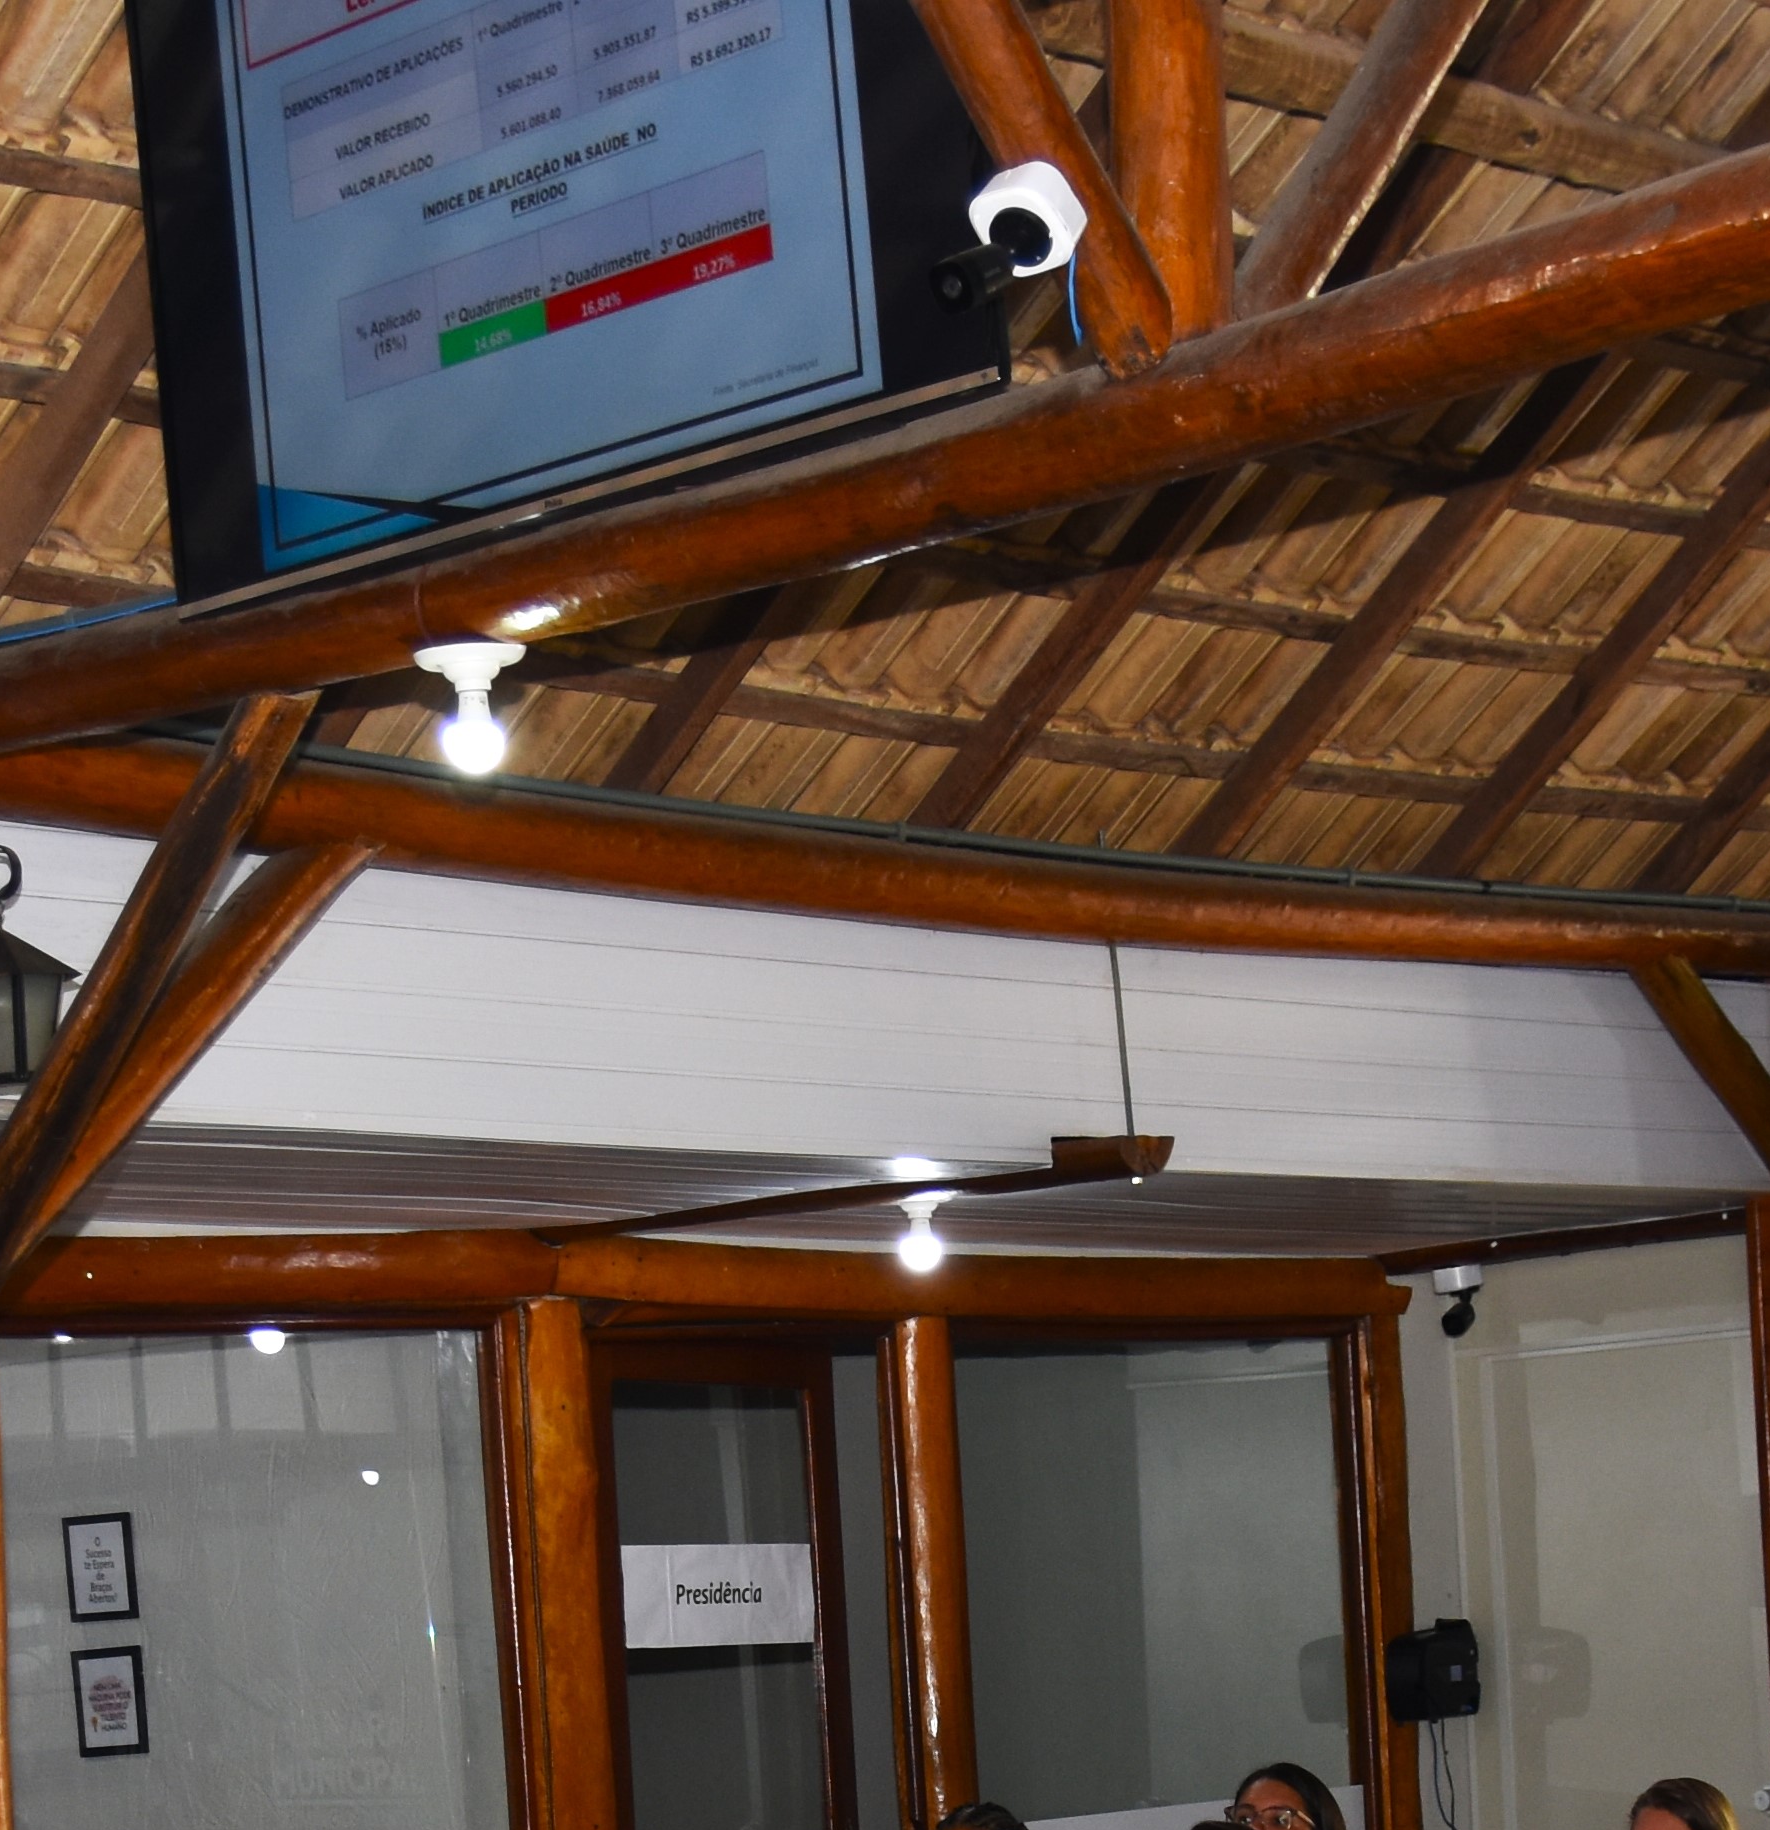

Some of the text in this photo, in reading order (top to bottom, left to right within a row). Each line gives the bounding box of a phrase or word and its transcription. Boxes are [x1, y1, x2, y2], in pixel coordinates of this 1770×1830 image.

[283, 36, 463, 120] DEMONSTRATIVO DE APLICAÇÕES
[334, 112, 431, 161] VALOR RECEBIDO
[339, 154, 434, 201] VALOR APLICADO
[422, 122, 658, 220] ÍNDICE DE APLICAÇÃO NA SAÚDE NO
[510, 181, 568, 213] PERÍODO
[676, 208, 766, 248] Quadrimestre
[565, 247, 651, 287] Quadrimestre
[370, 307, 422, 337] Aplicado
[458, 284, 541, 323] Quadrimestre
[676, 1581, 762, 1605] Presidência
